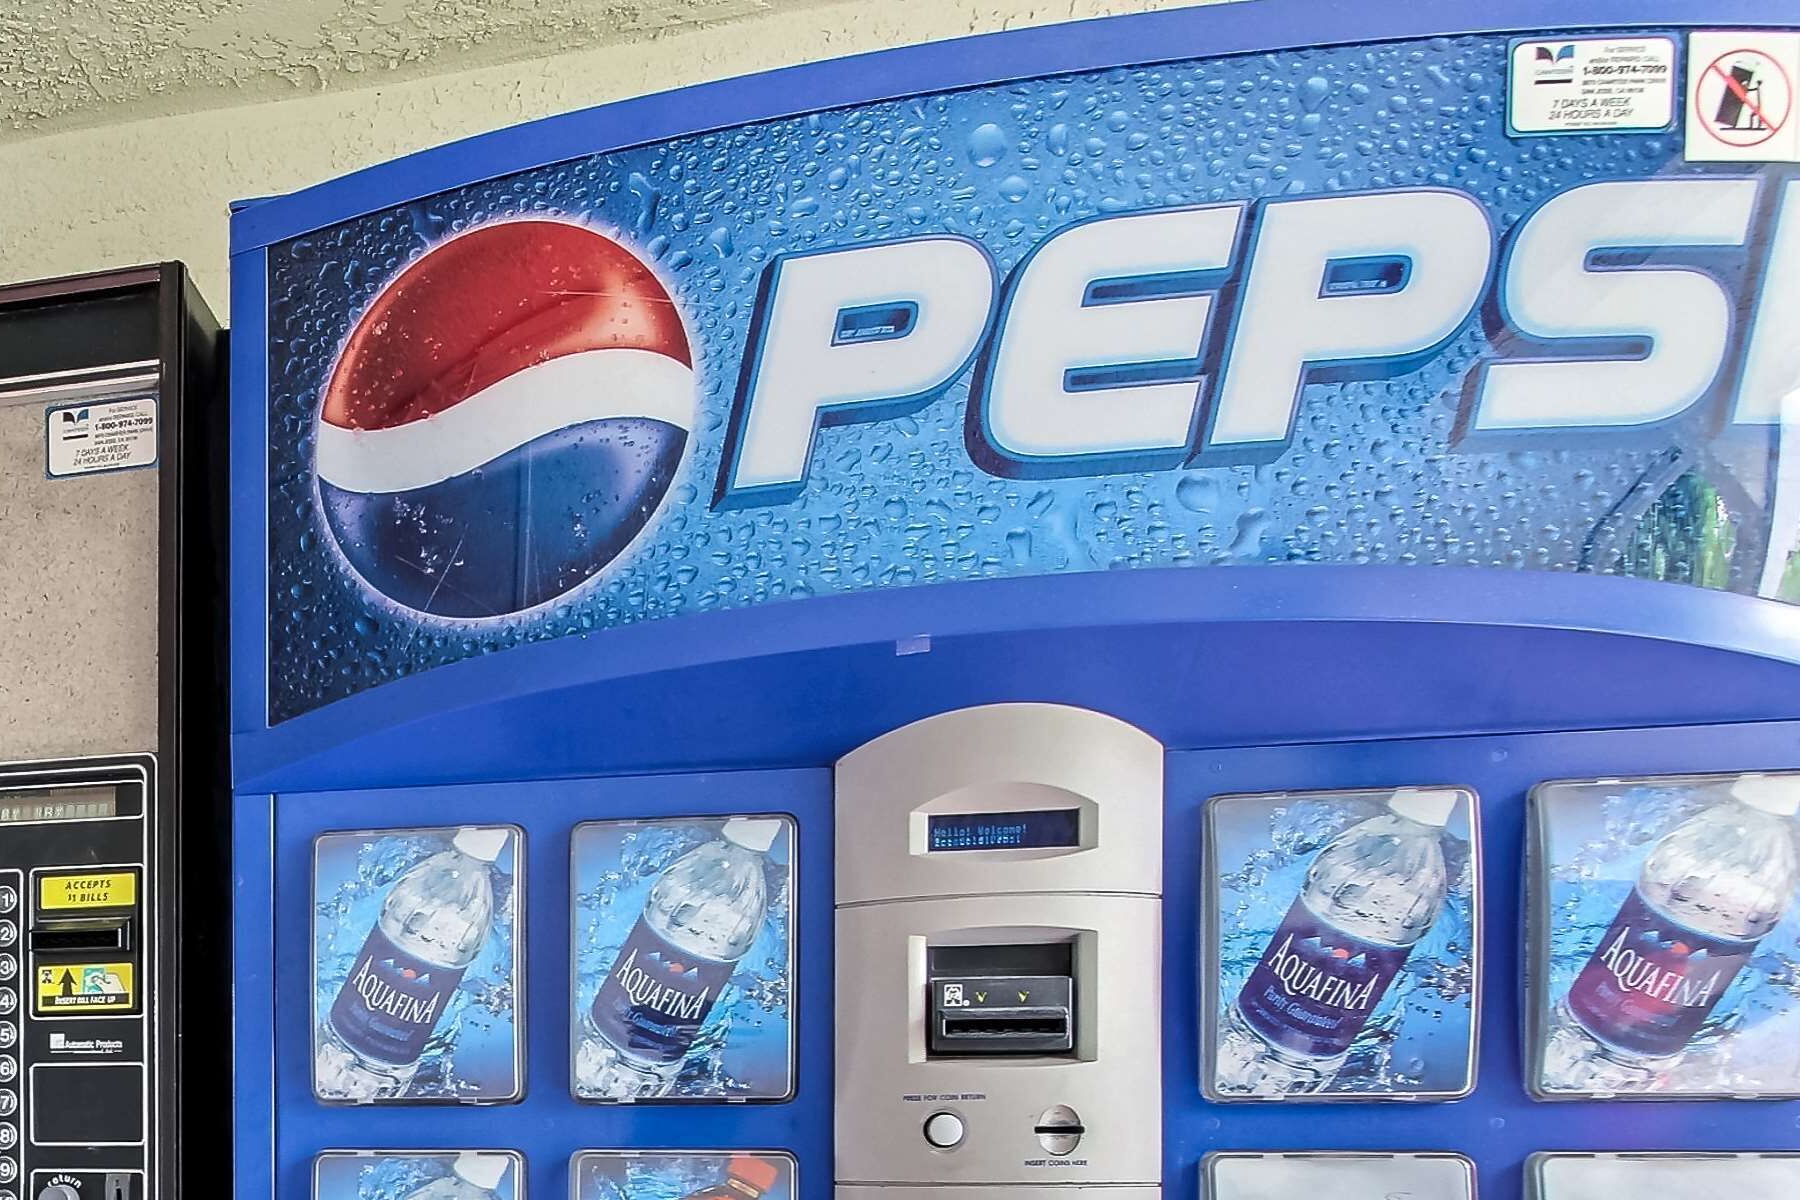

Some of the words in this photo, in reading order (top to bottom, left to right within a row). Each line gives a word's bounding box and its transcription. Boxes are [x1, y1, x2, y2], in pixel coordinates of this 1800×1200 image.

[1561, 98, 1588, 108] DAYS
[1599, 97, 1632, 107] WEEK
[1563, 109, 1602, 120] HOURS
[1612, 108, 1634, 118] DAY
[933, 826, 970, 836] Hello!
[977, 823, 1027, 836] Welcome!
[65, 879, 112, 890] ACCEPTS
[1, 894, 10, 906] 1
[80, 892, 108, 902] BILLS
[0, 928, 11, 941] 2
[0, 961, 11, 974] 3
[1268, 933, 1380, 1010] AQUAFINA
[1600, 926, 1722, 1008] AQUAFINA
[352, 954, 441, 1024] AQUAFINA
[616, 948, 710, 1020] AQUAFINA
[0, 995, 12, 1009] 4
[0, 1028, 12, 1043] 5
[0, 1062, 12, 1077] 6
[0, 1096, 11, 1110] 7
[0, 1129, 12, 1144] 8
[0, 1162, 11, 1176] 9
